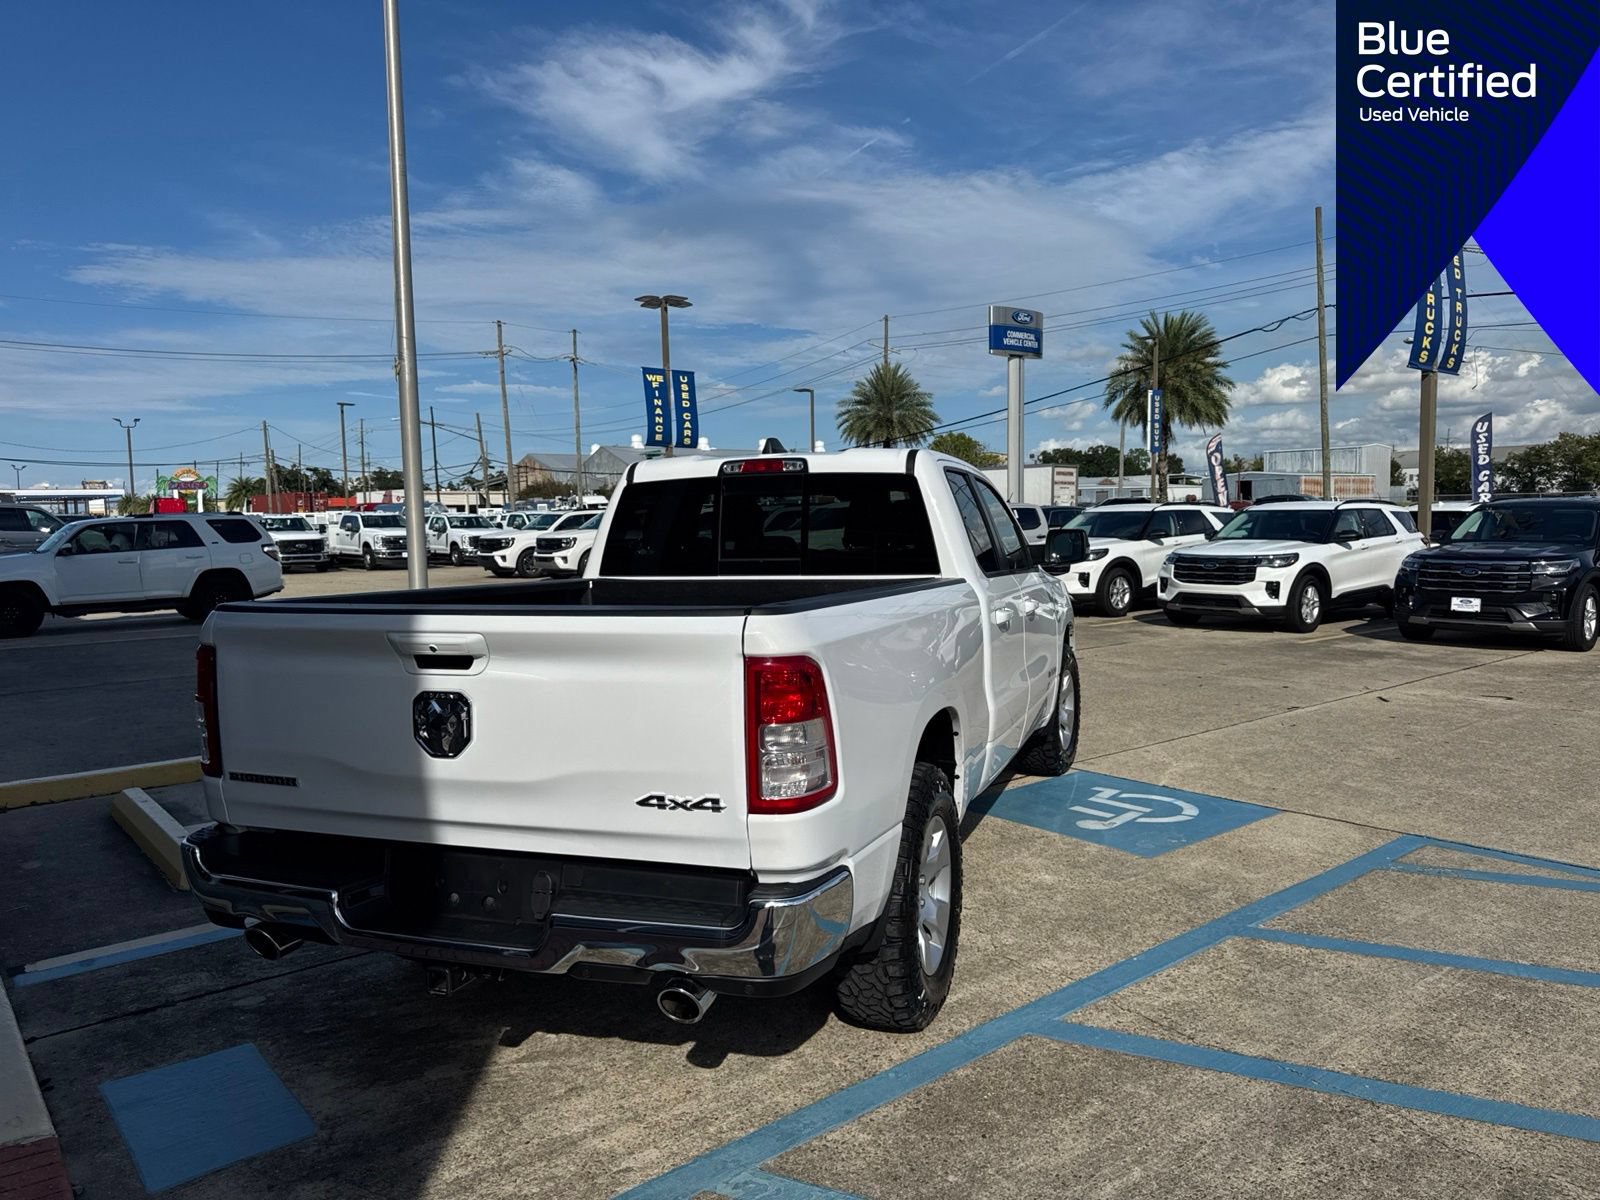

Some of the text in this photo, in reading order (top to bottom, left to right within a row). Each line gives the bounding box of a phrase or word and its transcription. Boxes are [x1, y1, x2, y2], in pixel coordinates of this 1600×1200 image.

[1006, 330, 1036, 341] COMMERCIAL
[1017, 312, 1032, 322] Ford
[1446, 287, 1462, 369] TRUCKS
[1003, 337, 1039, 349] VEHICLE CENTER
[646, 374, 664, 382] WE
[652, 382, 663, 441] FINANCE
[680, 375, 692, 445] USED CARS
[1475, 421, 1490, 465] USED
[1211, 452, 1228, 507] OPEN
